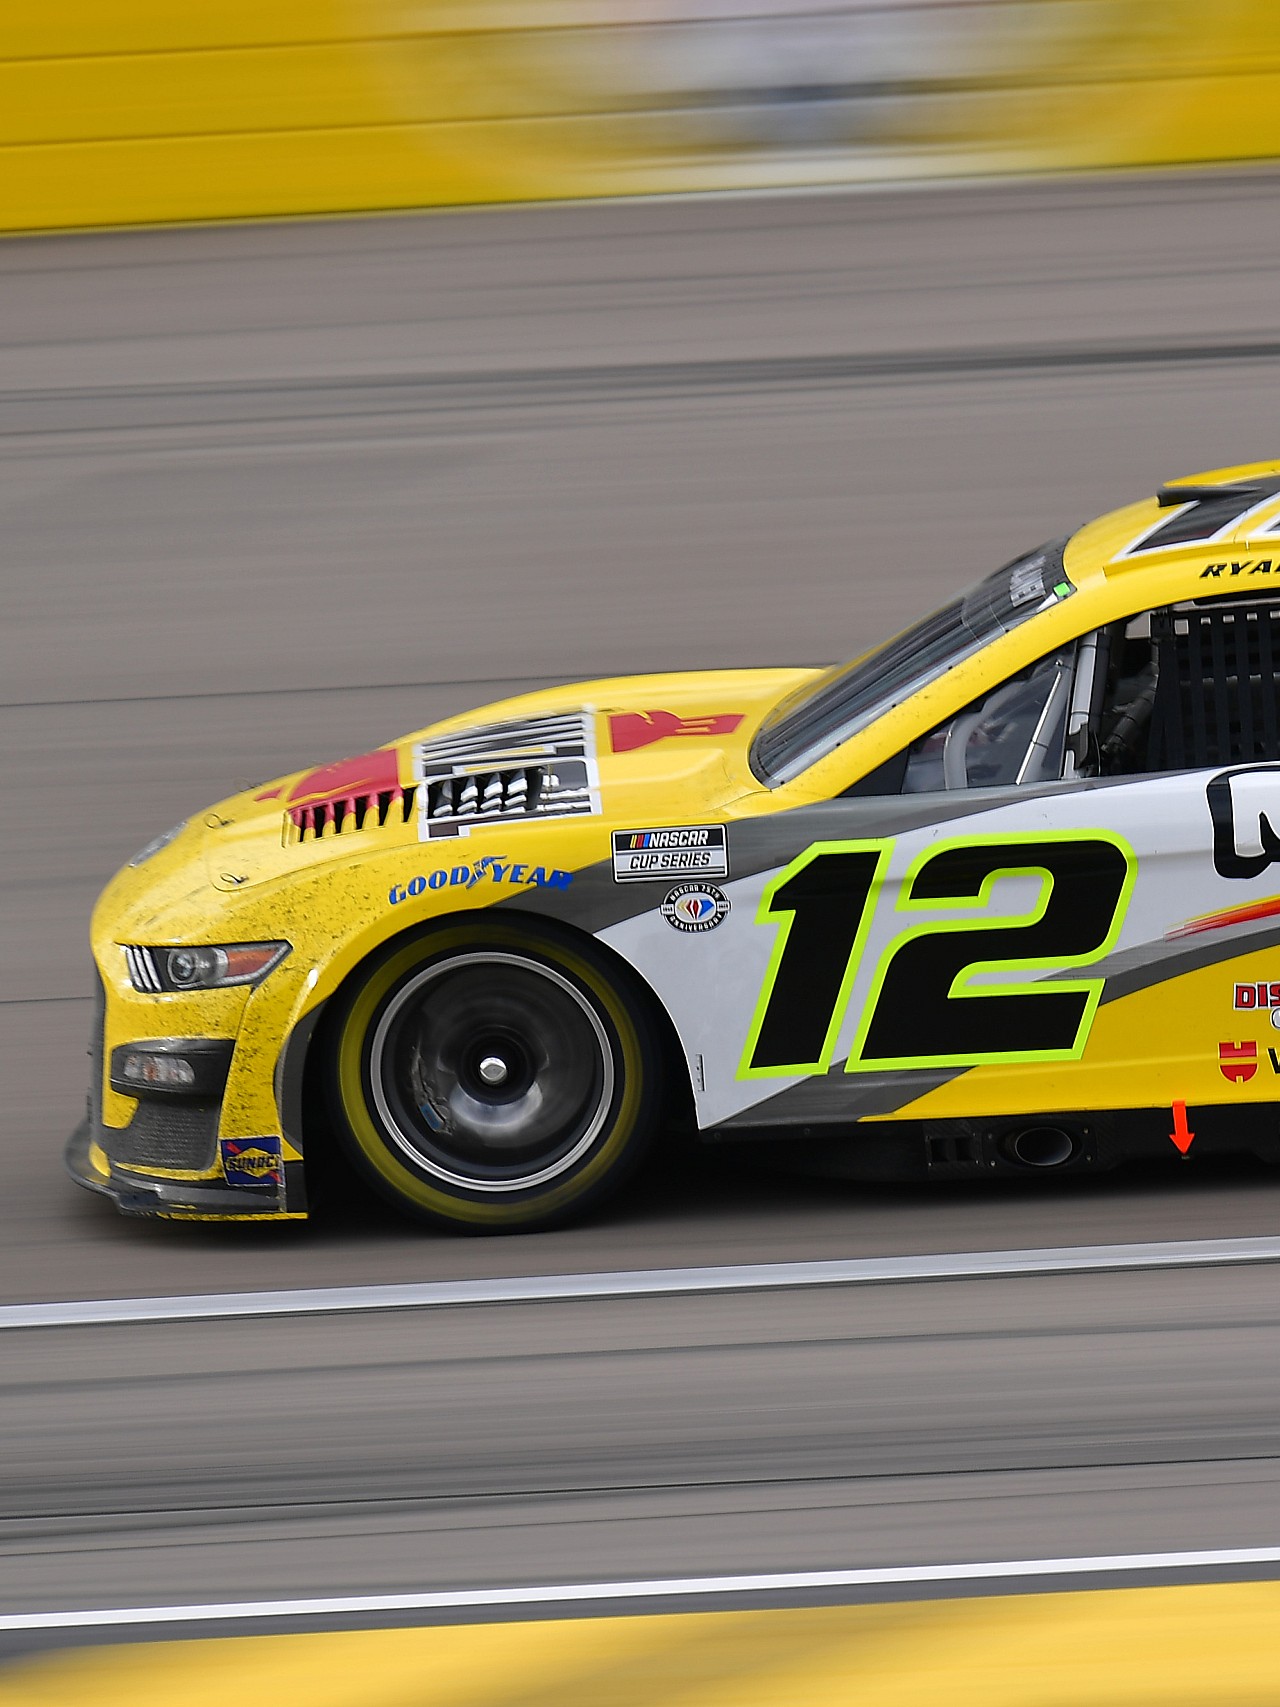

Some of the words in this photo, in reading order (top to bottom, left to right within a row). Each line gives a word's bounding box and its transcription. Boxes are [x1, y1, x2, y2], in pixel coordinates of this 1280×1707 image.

[649, 830, 709, 849] NASCAR
[629, 854, 659, 870] CUP
[660, 851, 712, 868] SERIES
[388, 855, 575, 905] GOODYEAR
[736, 829, 1138, 1081] 12
